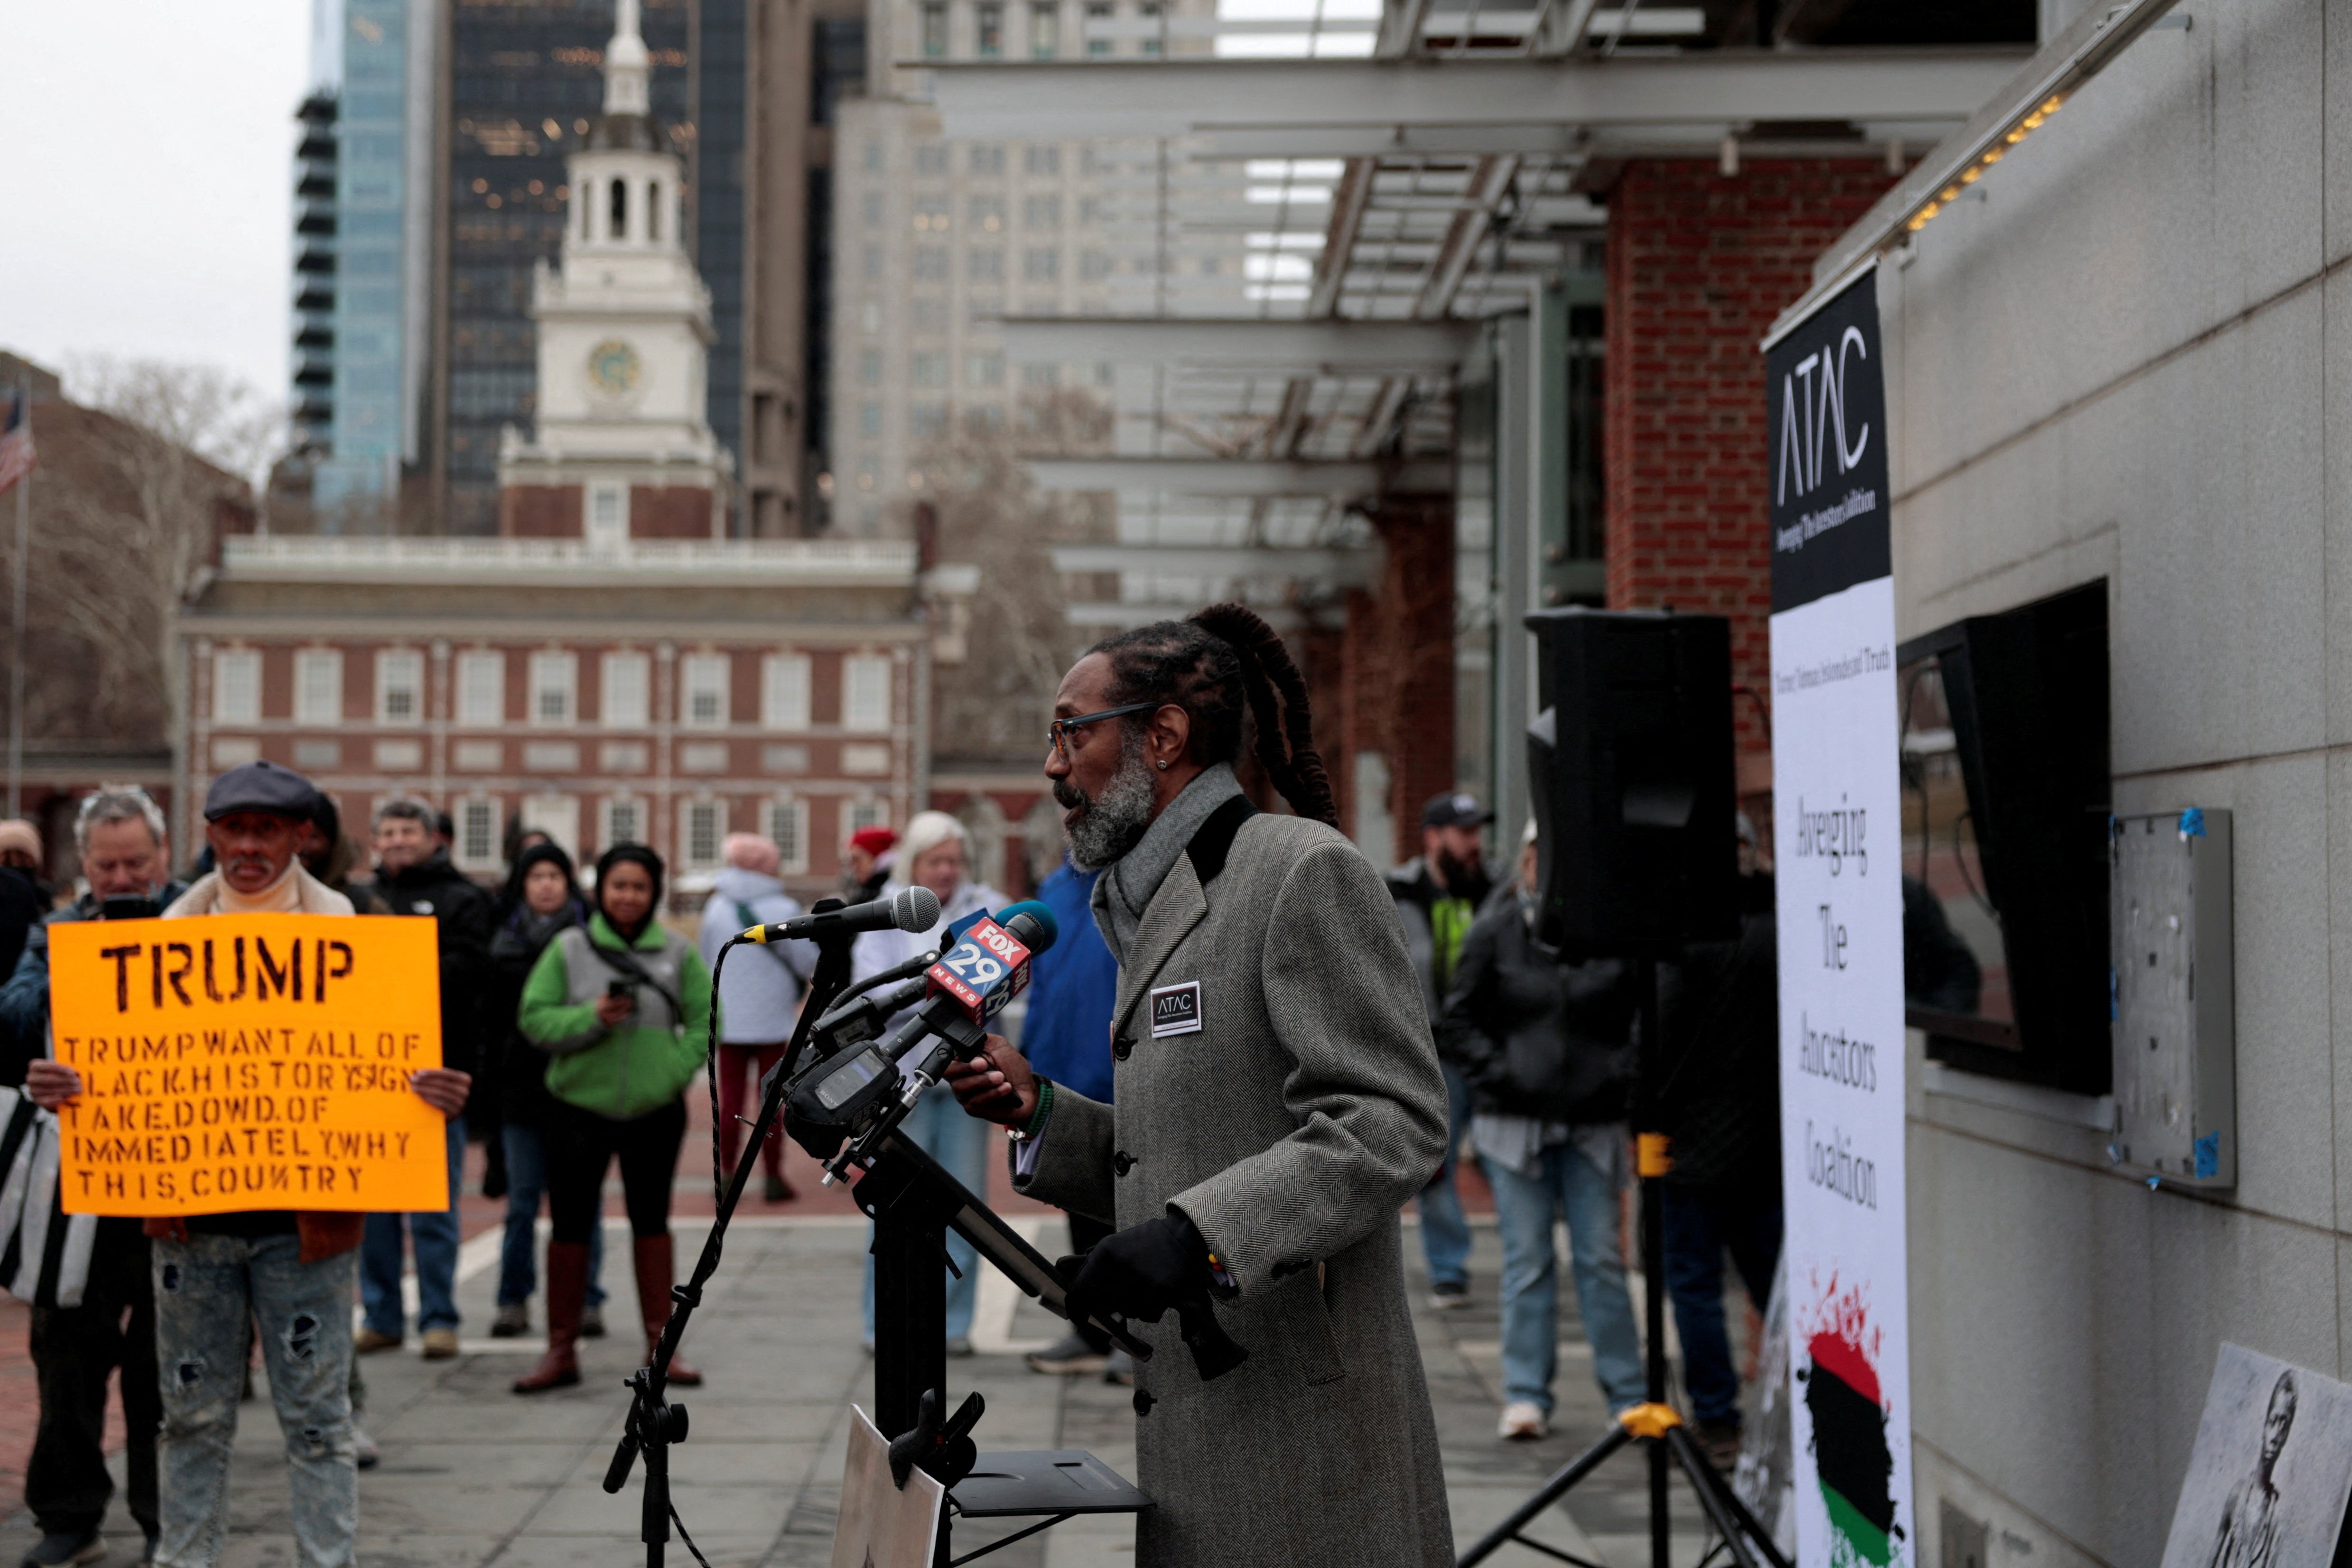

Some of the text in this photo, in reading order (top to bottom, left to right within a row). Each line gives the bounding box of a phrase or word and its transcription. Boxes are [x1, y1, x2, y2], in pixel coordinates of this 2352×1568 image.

[1777, 326, 1868, 507] ATAC
[976, 924, 1022, 962] FOX
[100, 936, 354, 1012] TRUMP
[944, 943, 1002, 985] 29
[1014, 961, 1028, 993] FOX
[934, 968, 976, 1002] NEWS
[986, 979, 1010, 1017] 29
[1158, 994, 1191, 1014] ATAC
[64, 1029, 420, 1064] TRUMP WANT ALL OF
[288, 1095, 327, 1123] OF
[819, 1090, 839, 1107] SONY
[337, 1131, 409, 1159] WHY
